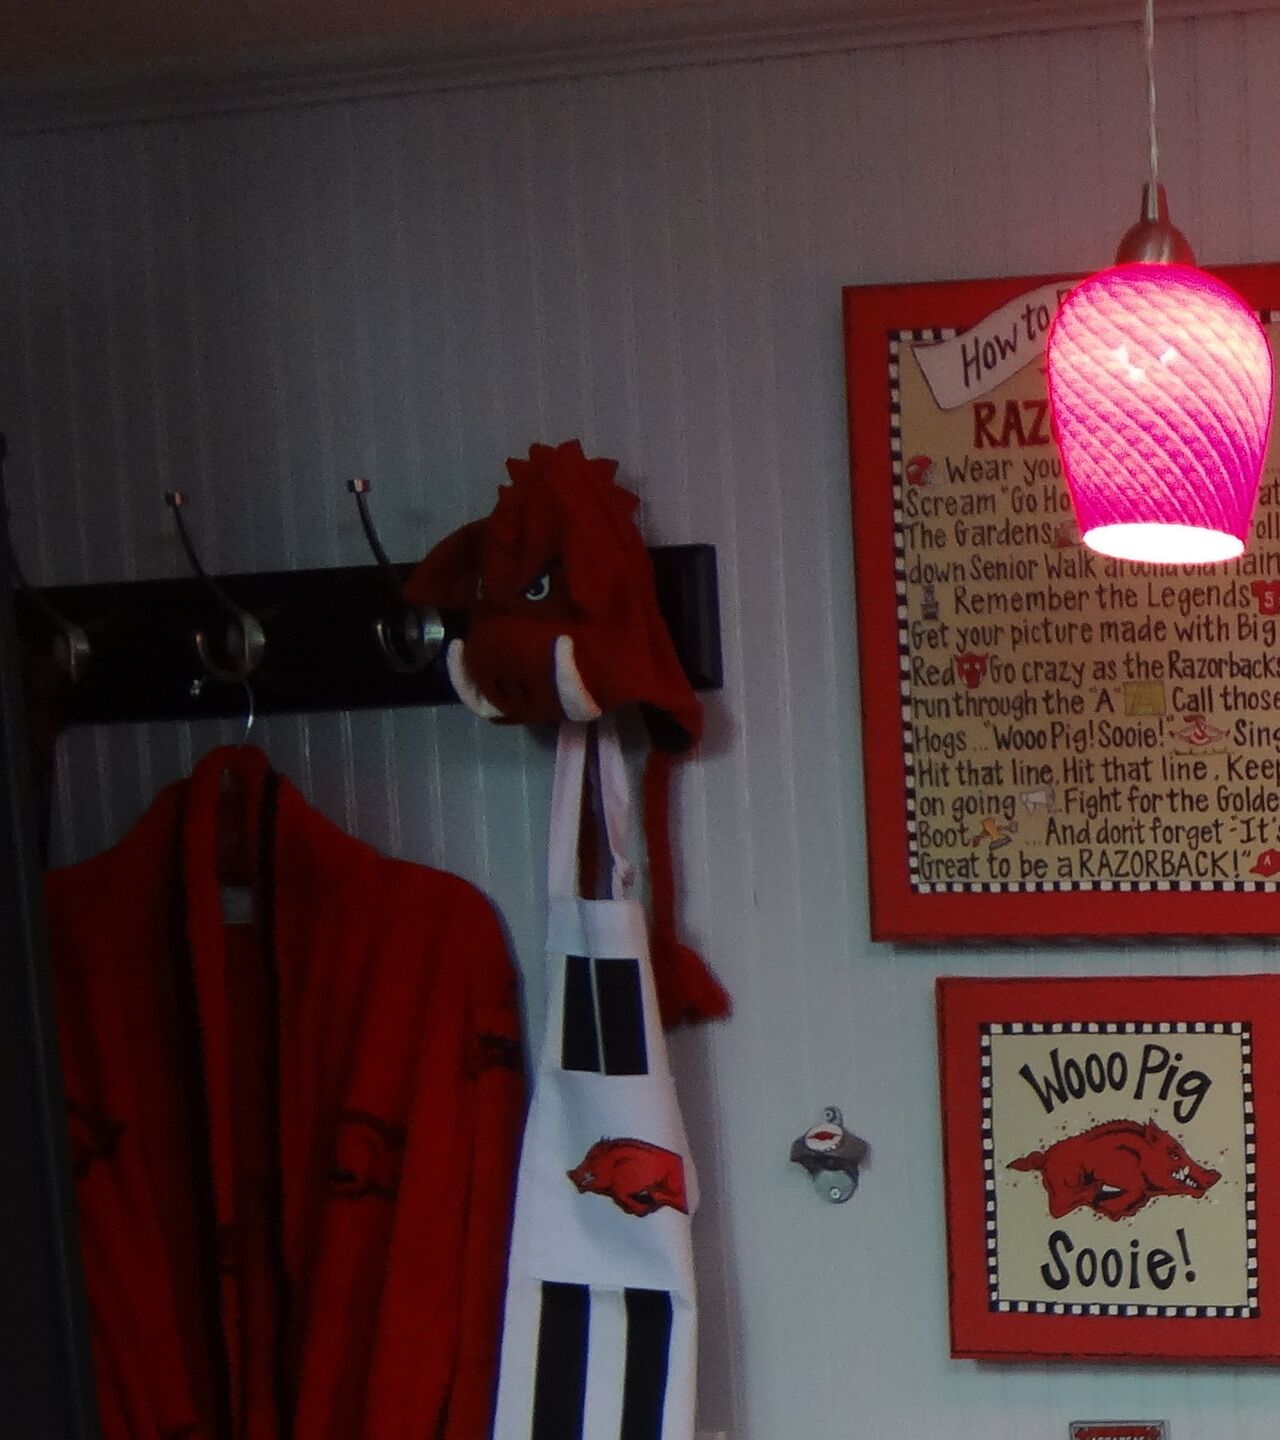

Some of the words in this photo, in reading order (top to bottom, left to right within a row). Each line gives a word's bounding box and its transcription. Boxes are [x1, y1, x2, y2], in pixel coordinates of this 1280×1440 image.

[961, 322, 1017, 389] How
[1021, 303, 1050, 341] to
[946, 455, 1013, 485] Wear
[1022, 458, 1063, 487] you
[906, 488, 996, 518] Scream
[1043, 484, 1073, 513] Ho
[904, 520, 947, 549] The
[955, 517, 1051, 548] Gardens
[909, 553, 966, 585] down
[970, 553, 1039, 582] Senior
[1044, 548, 1097, 581] Walk
[954, 586, 1090, 615] Remember
[1096, 582, 1138, 610] the
[1147, 579, 1250, 617] Legends
[911, 620, 949, 650] Get
[955, 623, 1005, 653] your
[1010, 617, 1094, 651] picture
[1100, 615, 1167, 644] made
[1174, 613, 1230, 643] with
[1237, 612, 1277, 647] Big
[912, 655, 955, 687] Red
[990, 654, 1016, 684] Go
[1022, 659, 1085, 689] crazy
[1093, 659, 1117, 681] as
[1123, 651, 1164, 680] the
[913, 696, 950, 719] run
[952, 690, 1038, 721] through
[1042, 688, 1085, 716] the
[1172, 685, 1214, 713] Call
[1051, 719, 1095, 754] Pig!
[917, 757, 950, 787] Hit
[955, 758, 1004, 786] that
[1062, 756, 1095, 784] Hit
[1100, 756, 1154, 783] that
[919, 796, 945, 817] on
[952, 789, 1016, 823] going
[1127, 784, 1163, 813] for
[1166, 786, 1209, 813] the
[918, 820, 970, 849] Boot
[1046, 816, 1091, 846] And
[1096, 816, 1146, 845] don't
[1150, 815, 1225, 851] forget
[918, 852, 980, 881] Great
[986, 851, 1011, 880] to
[1019, 849, 1049, 879] be
[1057, 855, 1073, 878] a
[1018, 1046, 1128, 1115] Wooo
[1132, 1043, 1213, 1124] Pig
[1040, 1228, 1196, 1291] Sooie!
